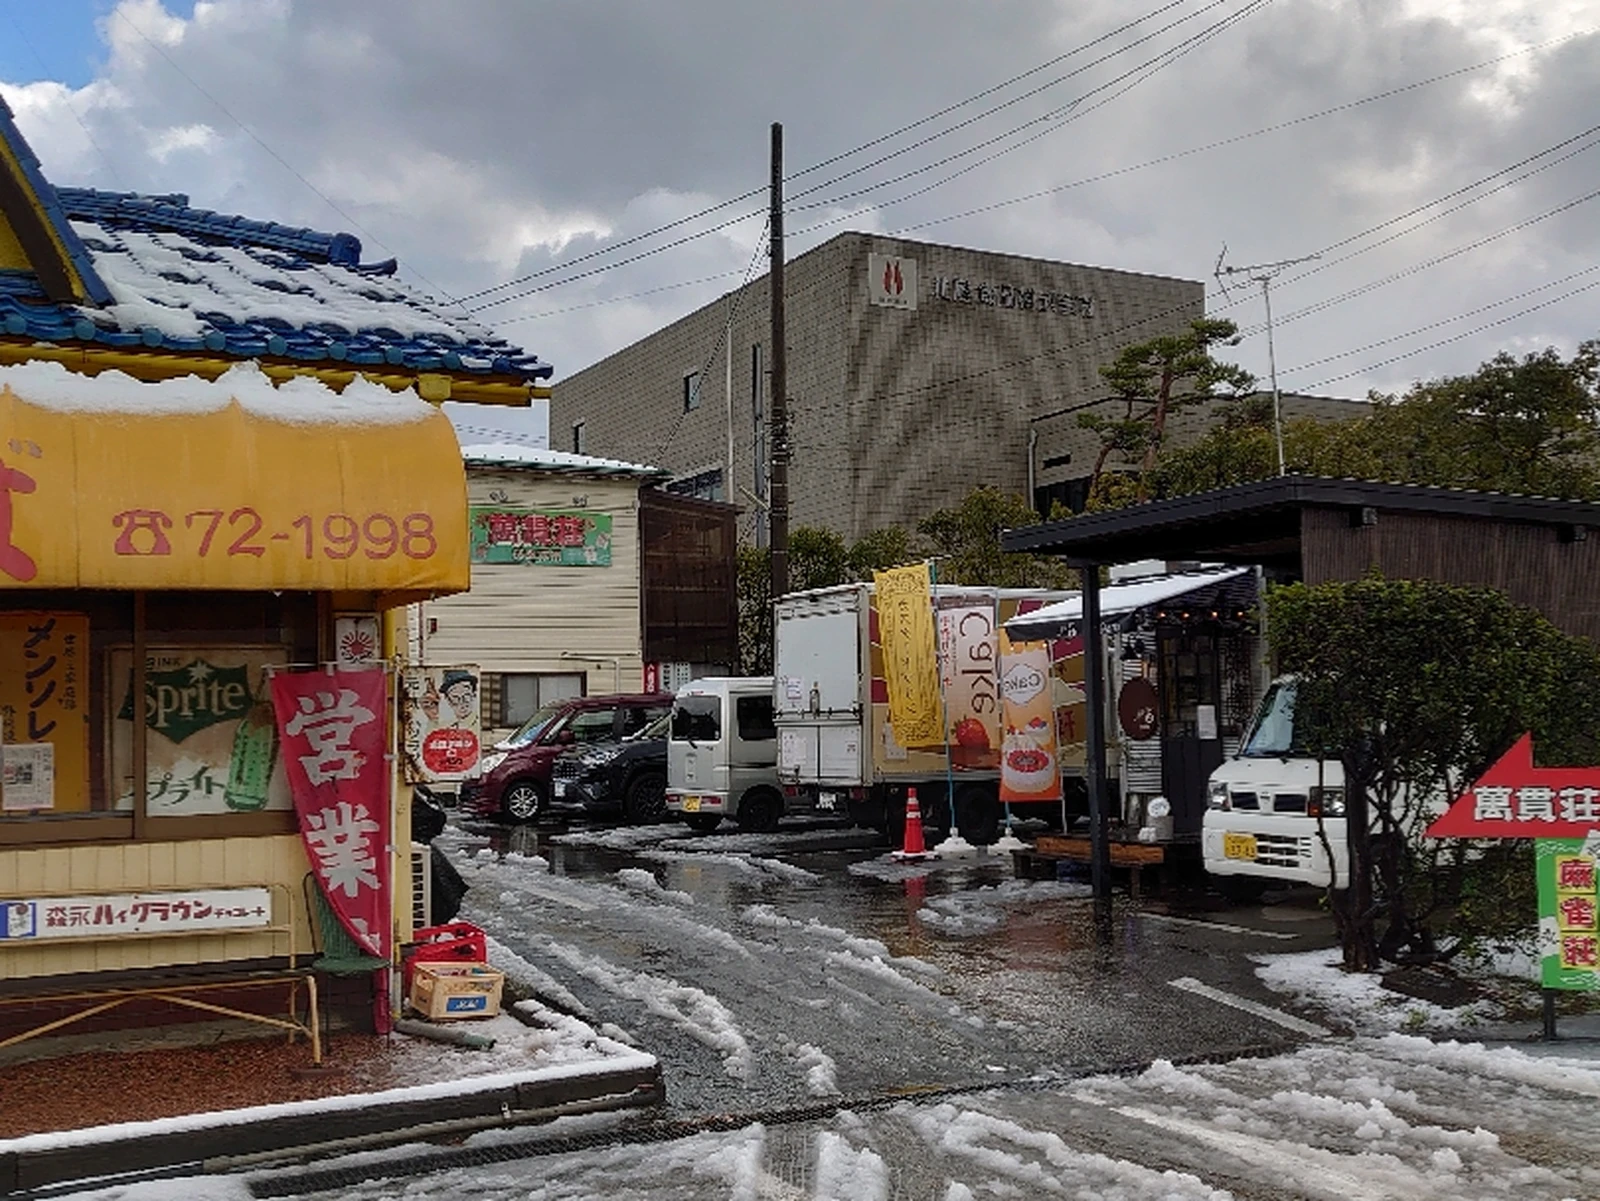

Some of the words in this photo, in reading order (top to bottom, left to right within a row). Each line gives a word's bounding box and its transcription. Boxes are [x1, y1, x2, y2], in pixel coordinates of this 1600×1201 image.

[185, 507, 437, 560] 72-1998
[1473, 785, 1600, 823] 萬貫荘
